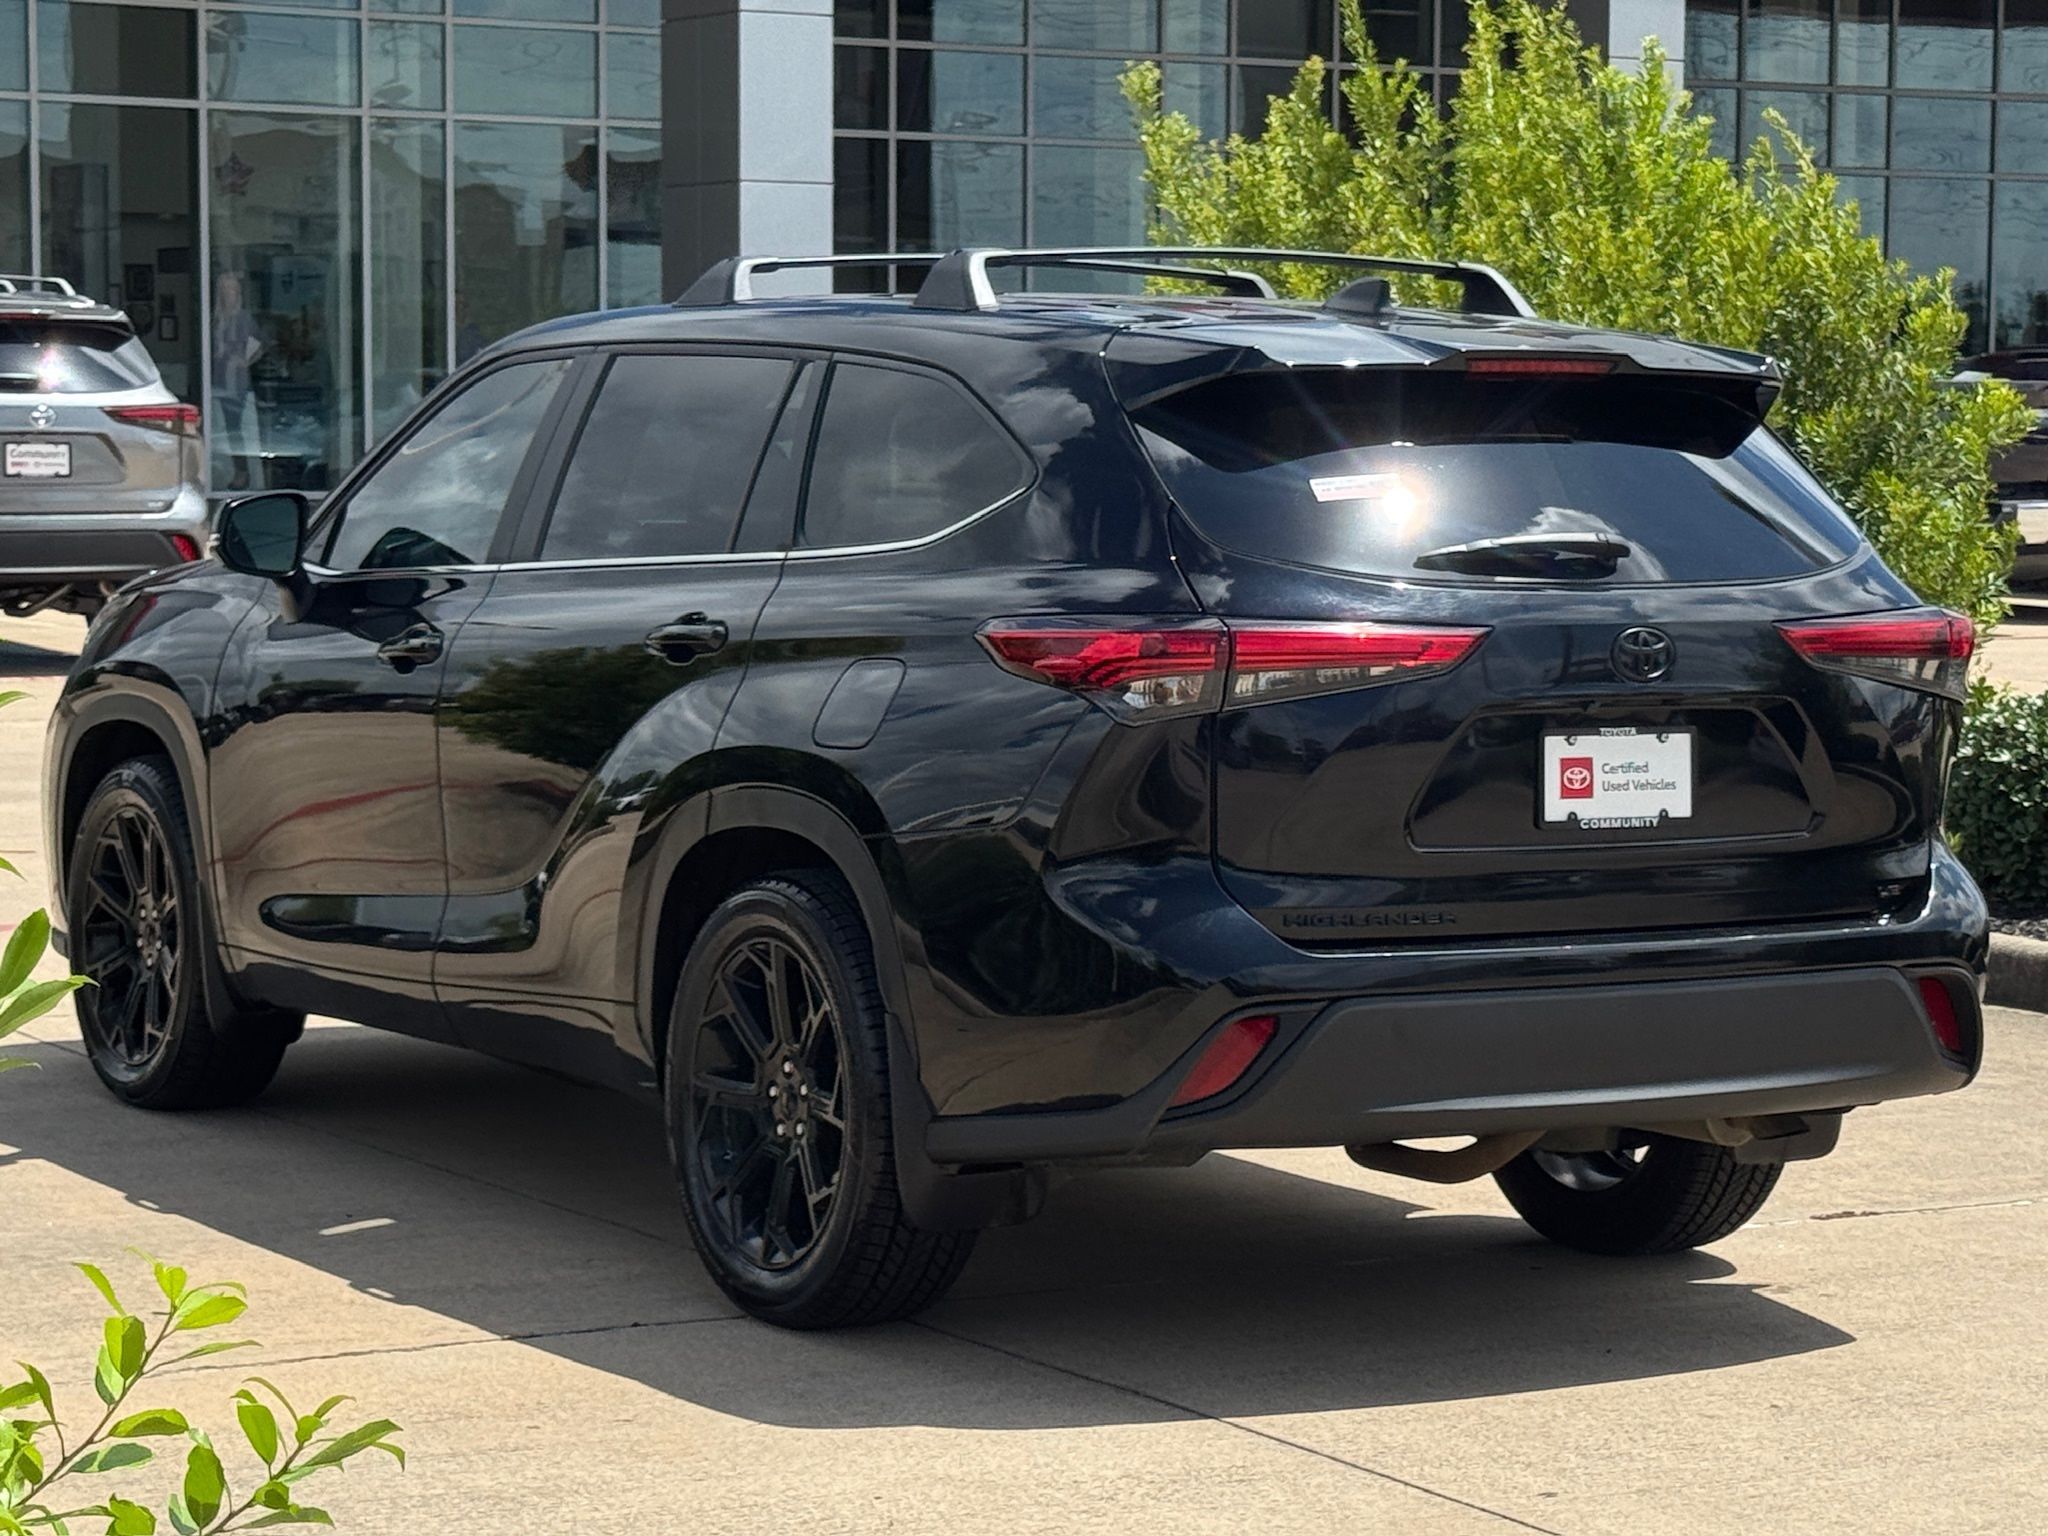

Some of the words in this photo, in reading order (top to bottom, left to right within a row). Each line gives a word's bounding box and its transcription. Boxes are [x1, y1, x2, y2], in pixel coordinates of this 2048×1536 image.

[1599, 726, 1637, 736] TOYOTA
[1601, 761, 1650, 774] Certified
[1601, 779, 1630, 792] Used
[1632, 777, 1677, 791] Vehicles
[1579, 816, 1660, 830] COMMUNITY
[1282, 911, 1457, 928] HIGHLANDER
